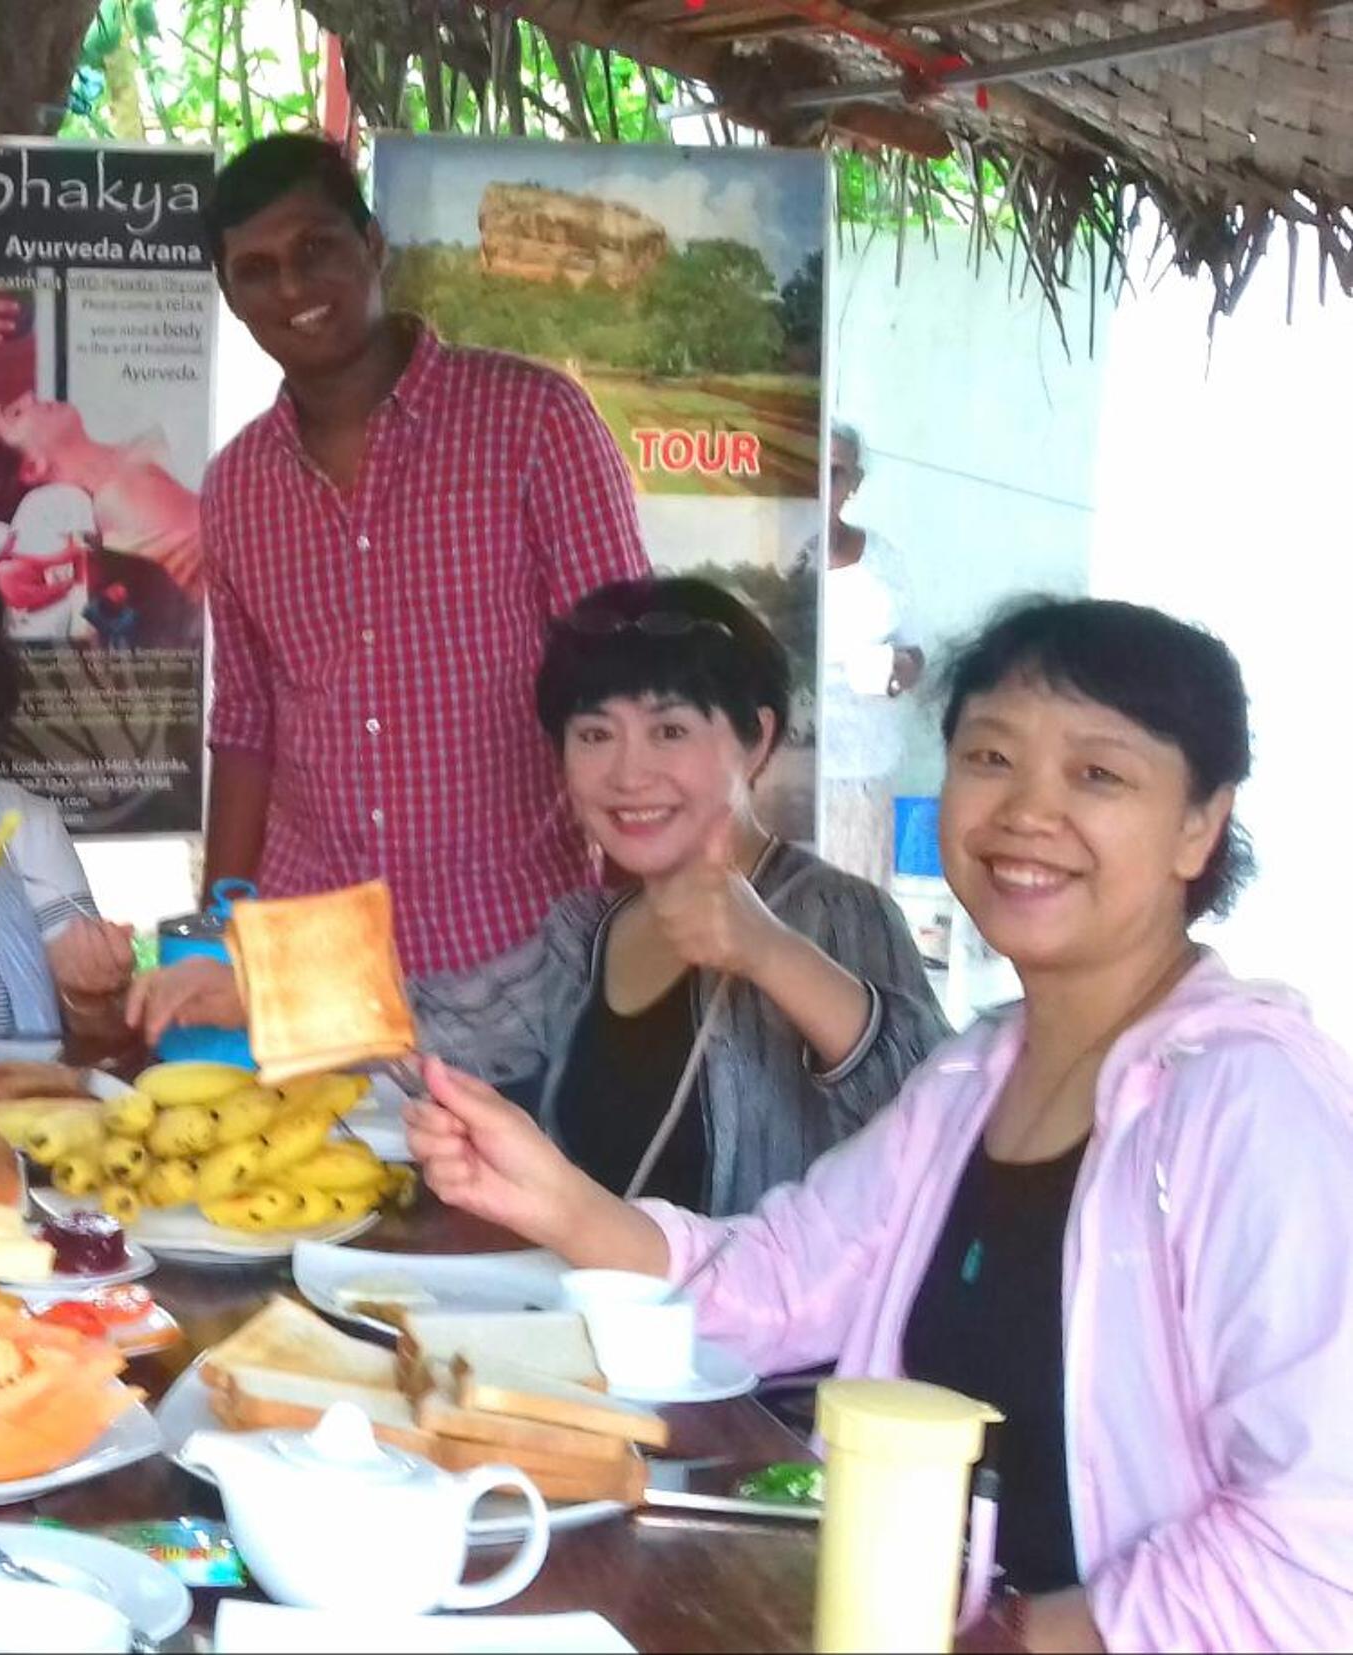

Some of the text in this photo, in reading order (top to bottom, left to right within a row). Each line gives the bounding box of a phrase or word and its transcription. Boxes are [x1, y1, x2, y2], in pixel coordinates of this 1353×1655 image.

[4, 234, 203, 264] Ayurveda Arana
[632, 427, 762, 476] TOUR
